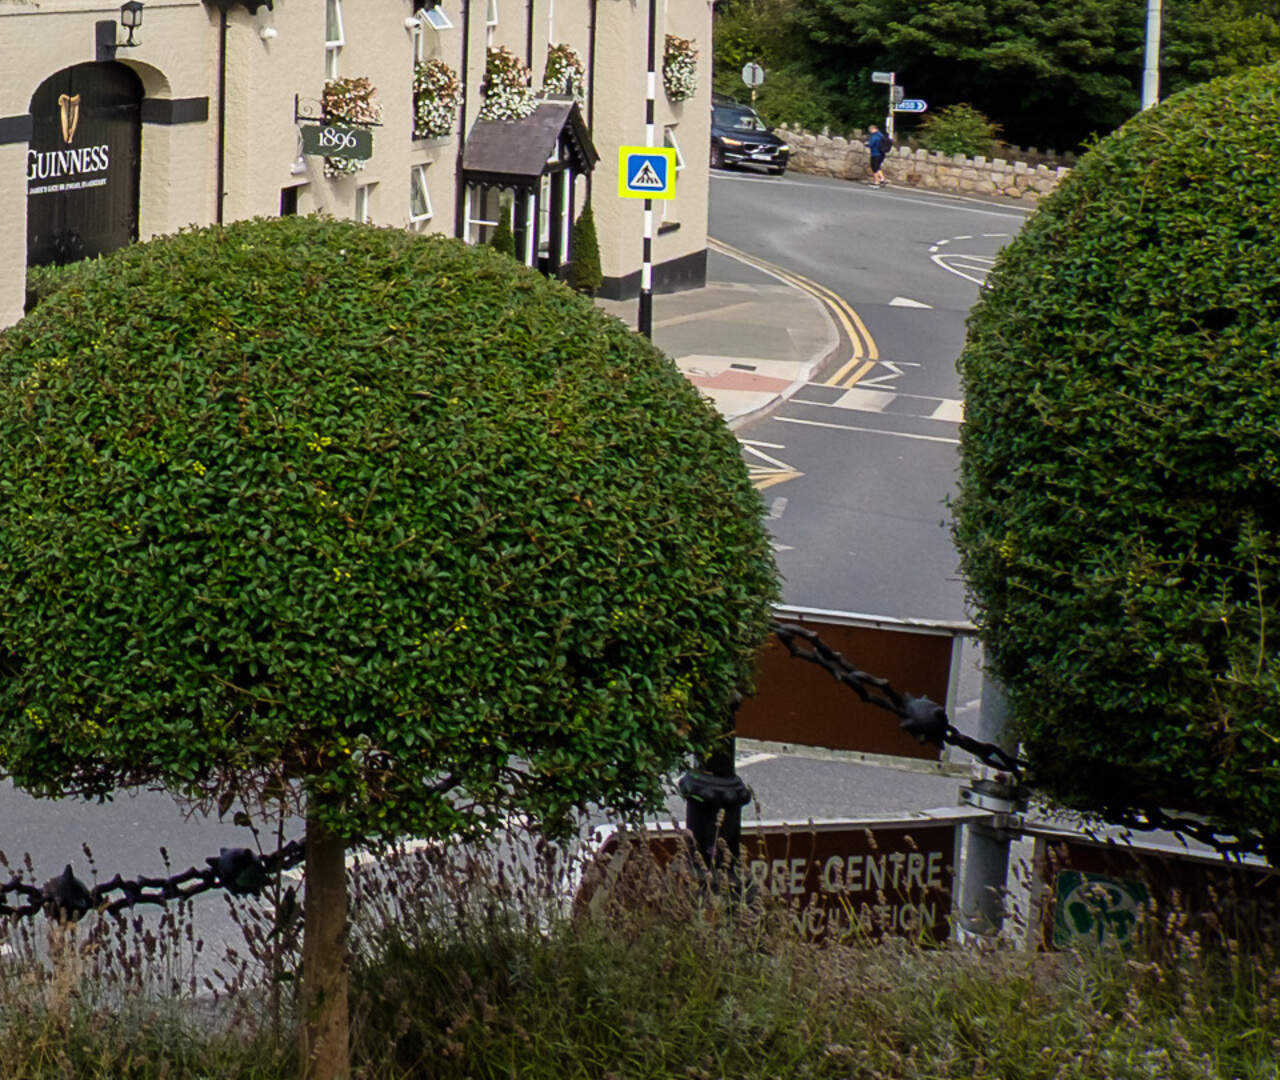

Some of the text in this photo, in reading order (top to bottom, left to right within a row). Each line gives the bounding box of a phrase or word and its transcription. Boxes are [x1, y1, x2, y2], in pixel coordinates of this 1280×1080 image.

[318, 127, 357, 152] 1896
[26, 144, 109, 180] GUINNESS
[823, 852, 943, 893] CENTRE
